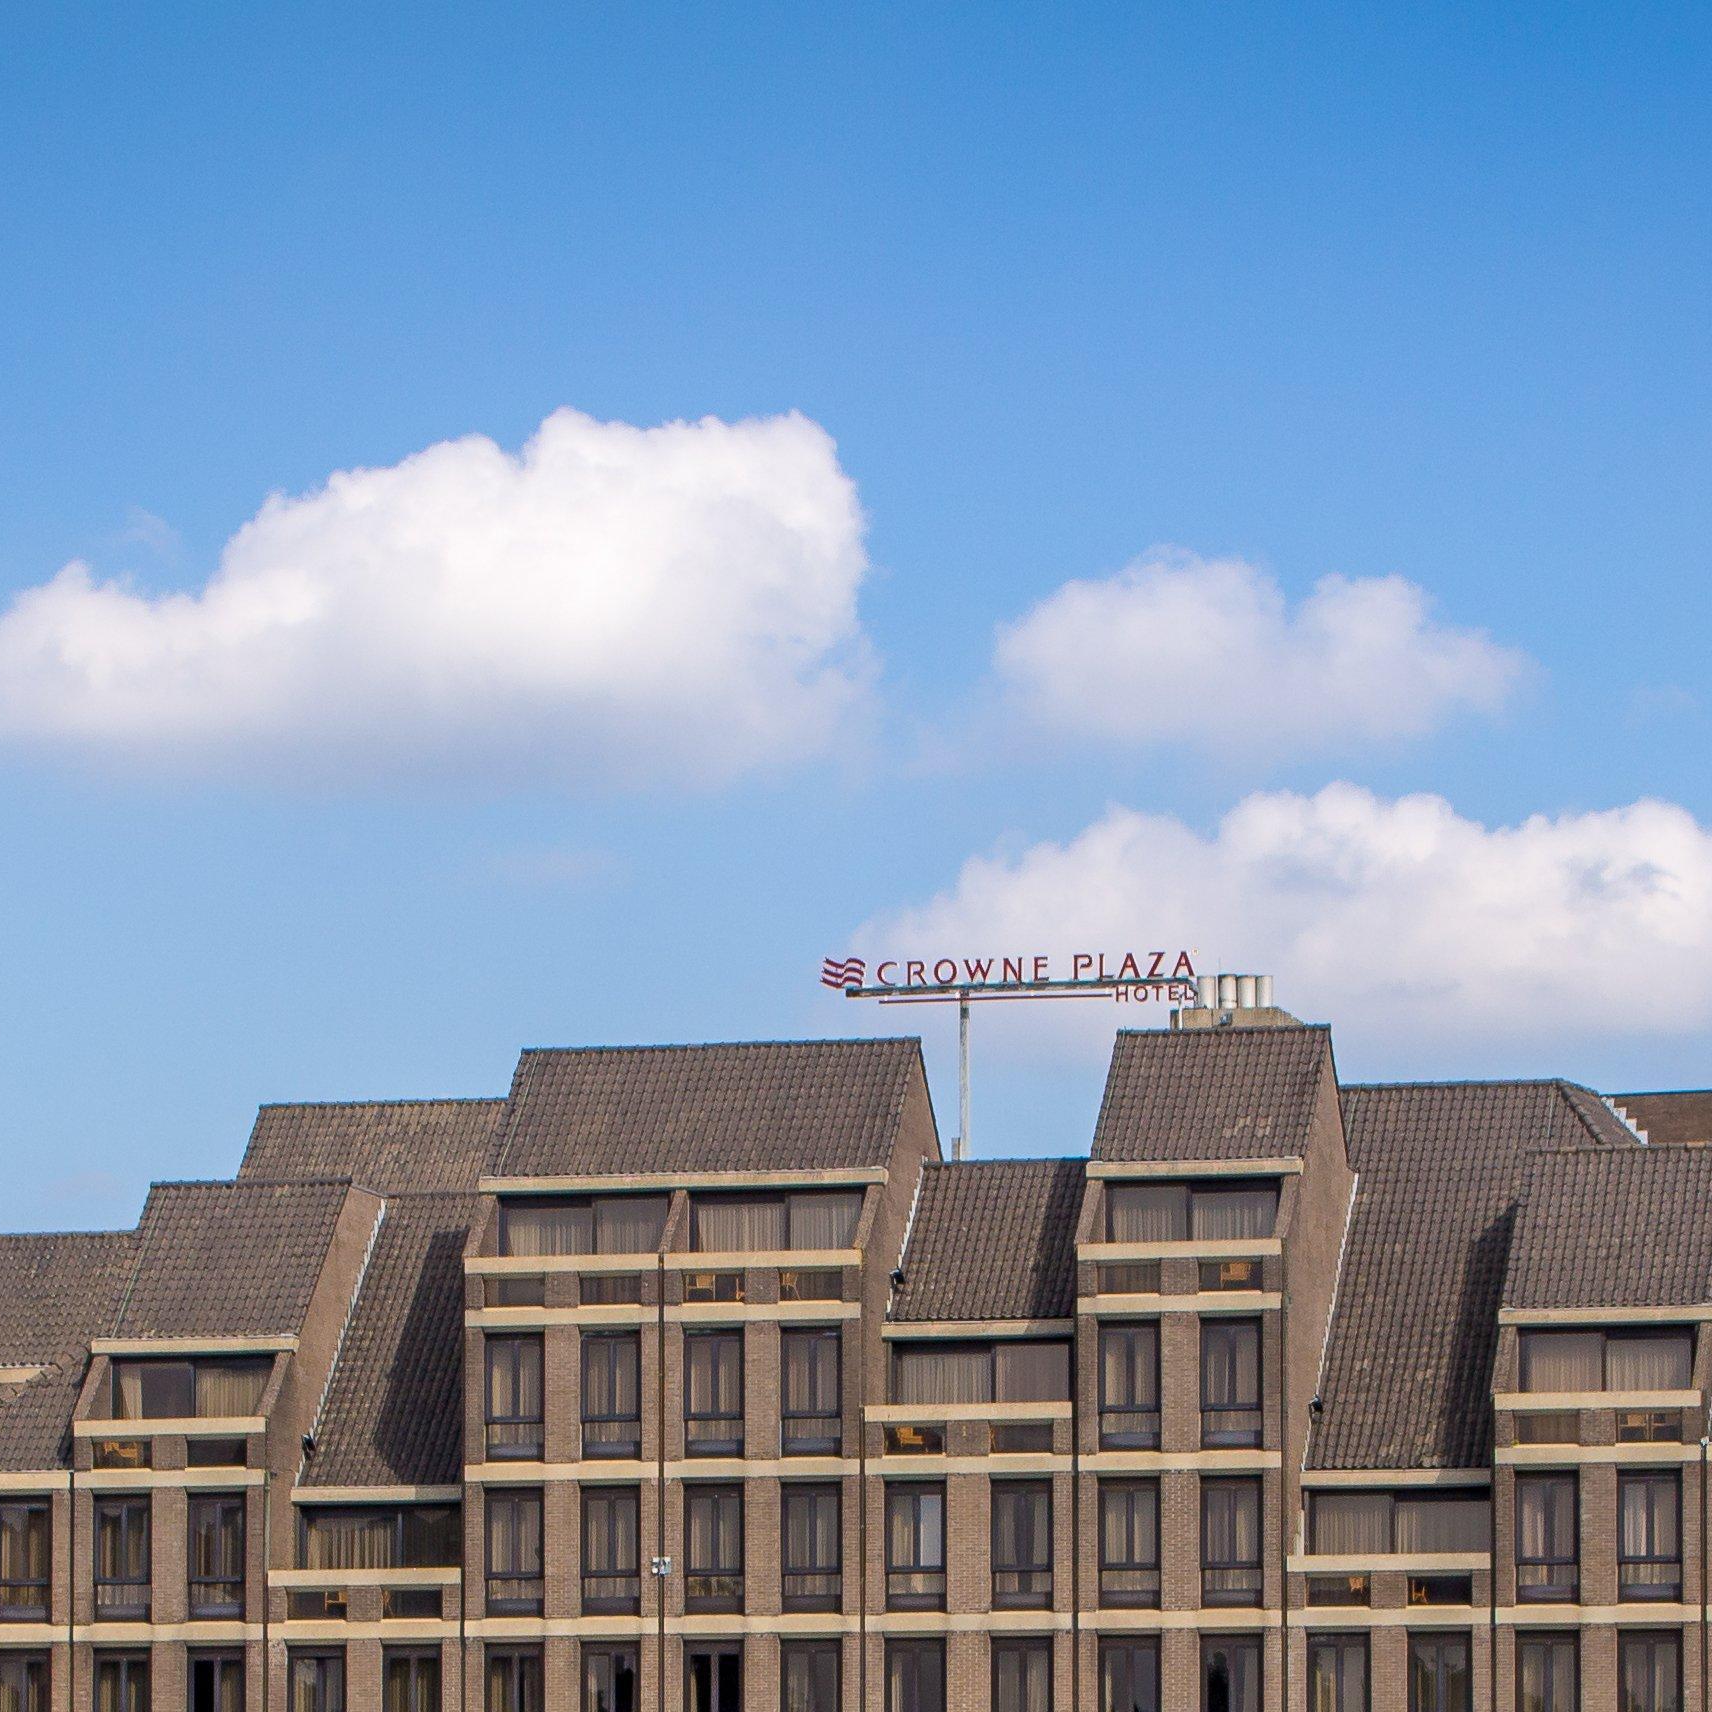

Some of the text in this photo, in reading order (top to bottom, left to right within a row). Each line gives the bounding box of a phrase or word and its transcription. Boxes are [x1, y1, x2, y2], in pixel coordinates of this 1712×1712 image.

[876, 950, 1195, 986] CROWNE PLAZA
[1115, 983, 1196, 1003] HOTEL
